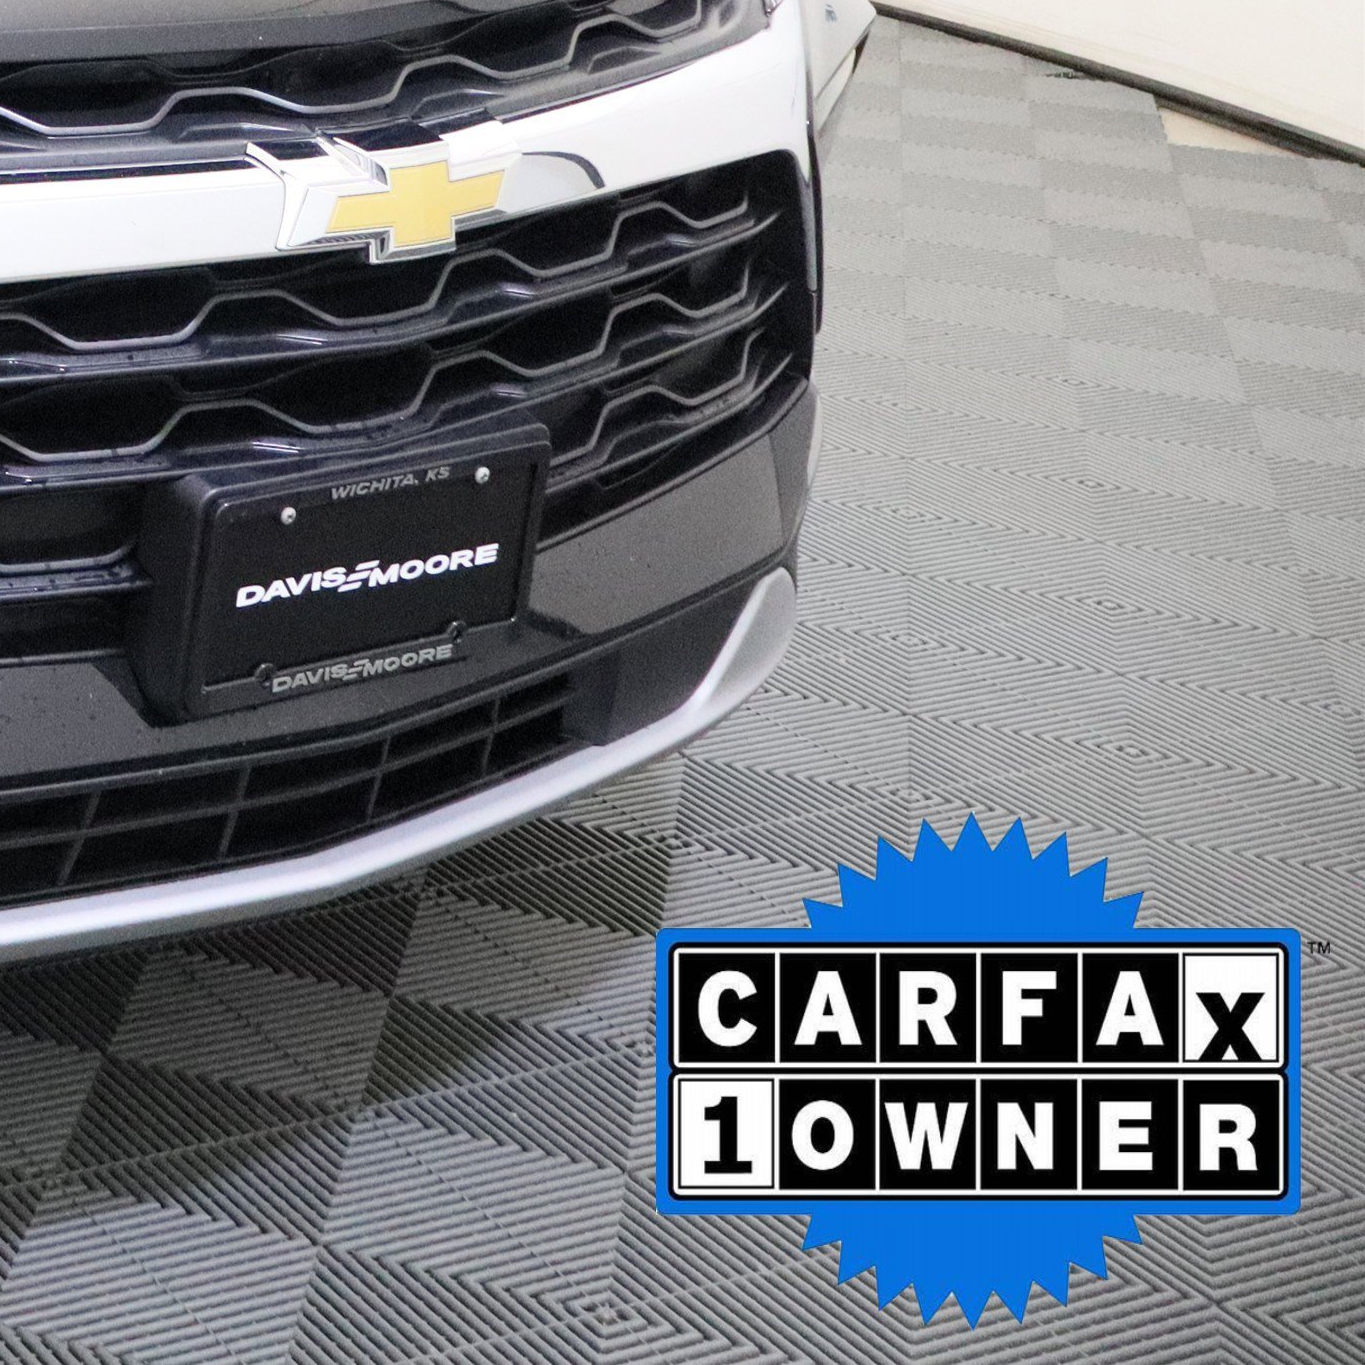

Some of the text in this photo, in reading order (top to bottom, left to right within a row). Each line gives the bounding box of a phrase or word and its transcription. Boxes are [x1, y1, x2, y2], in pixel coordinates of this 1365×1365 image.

[330, 466, 451, 501] WICHITA, KS
[235, 542, 500, 609] DAVIS MOORE
[271, 643, 455, 694] DAVIS MOORE
